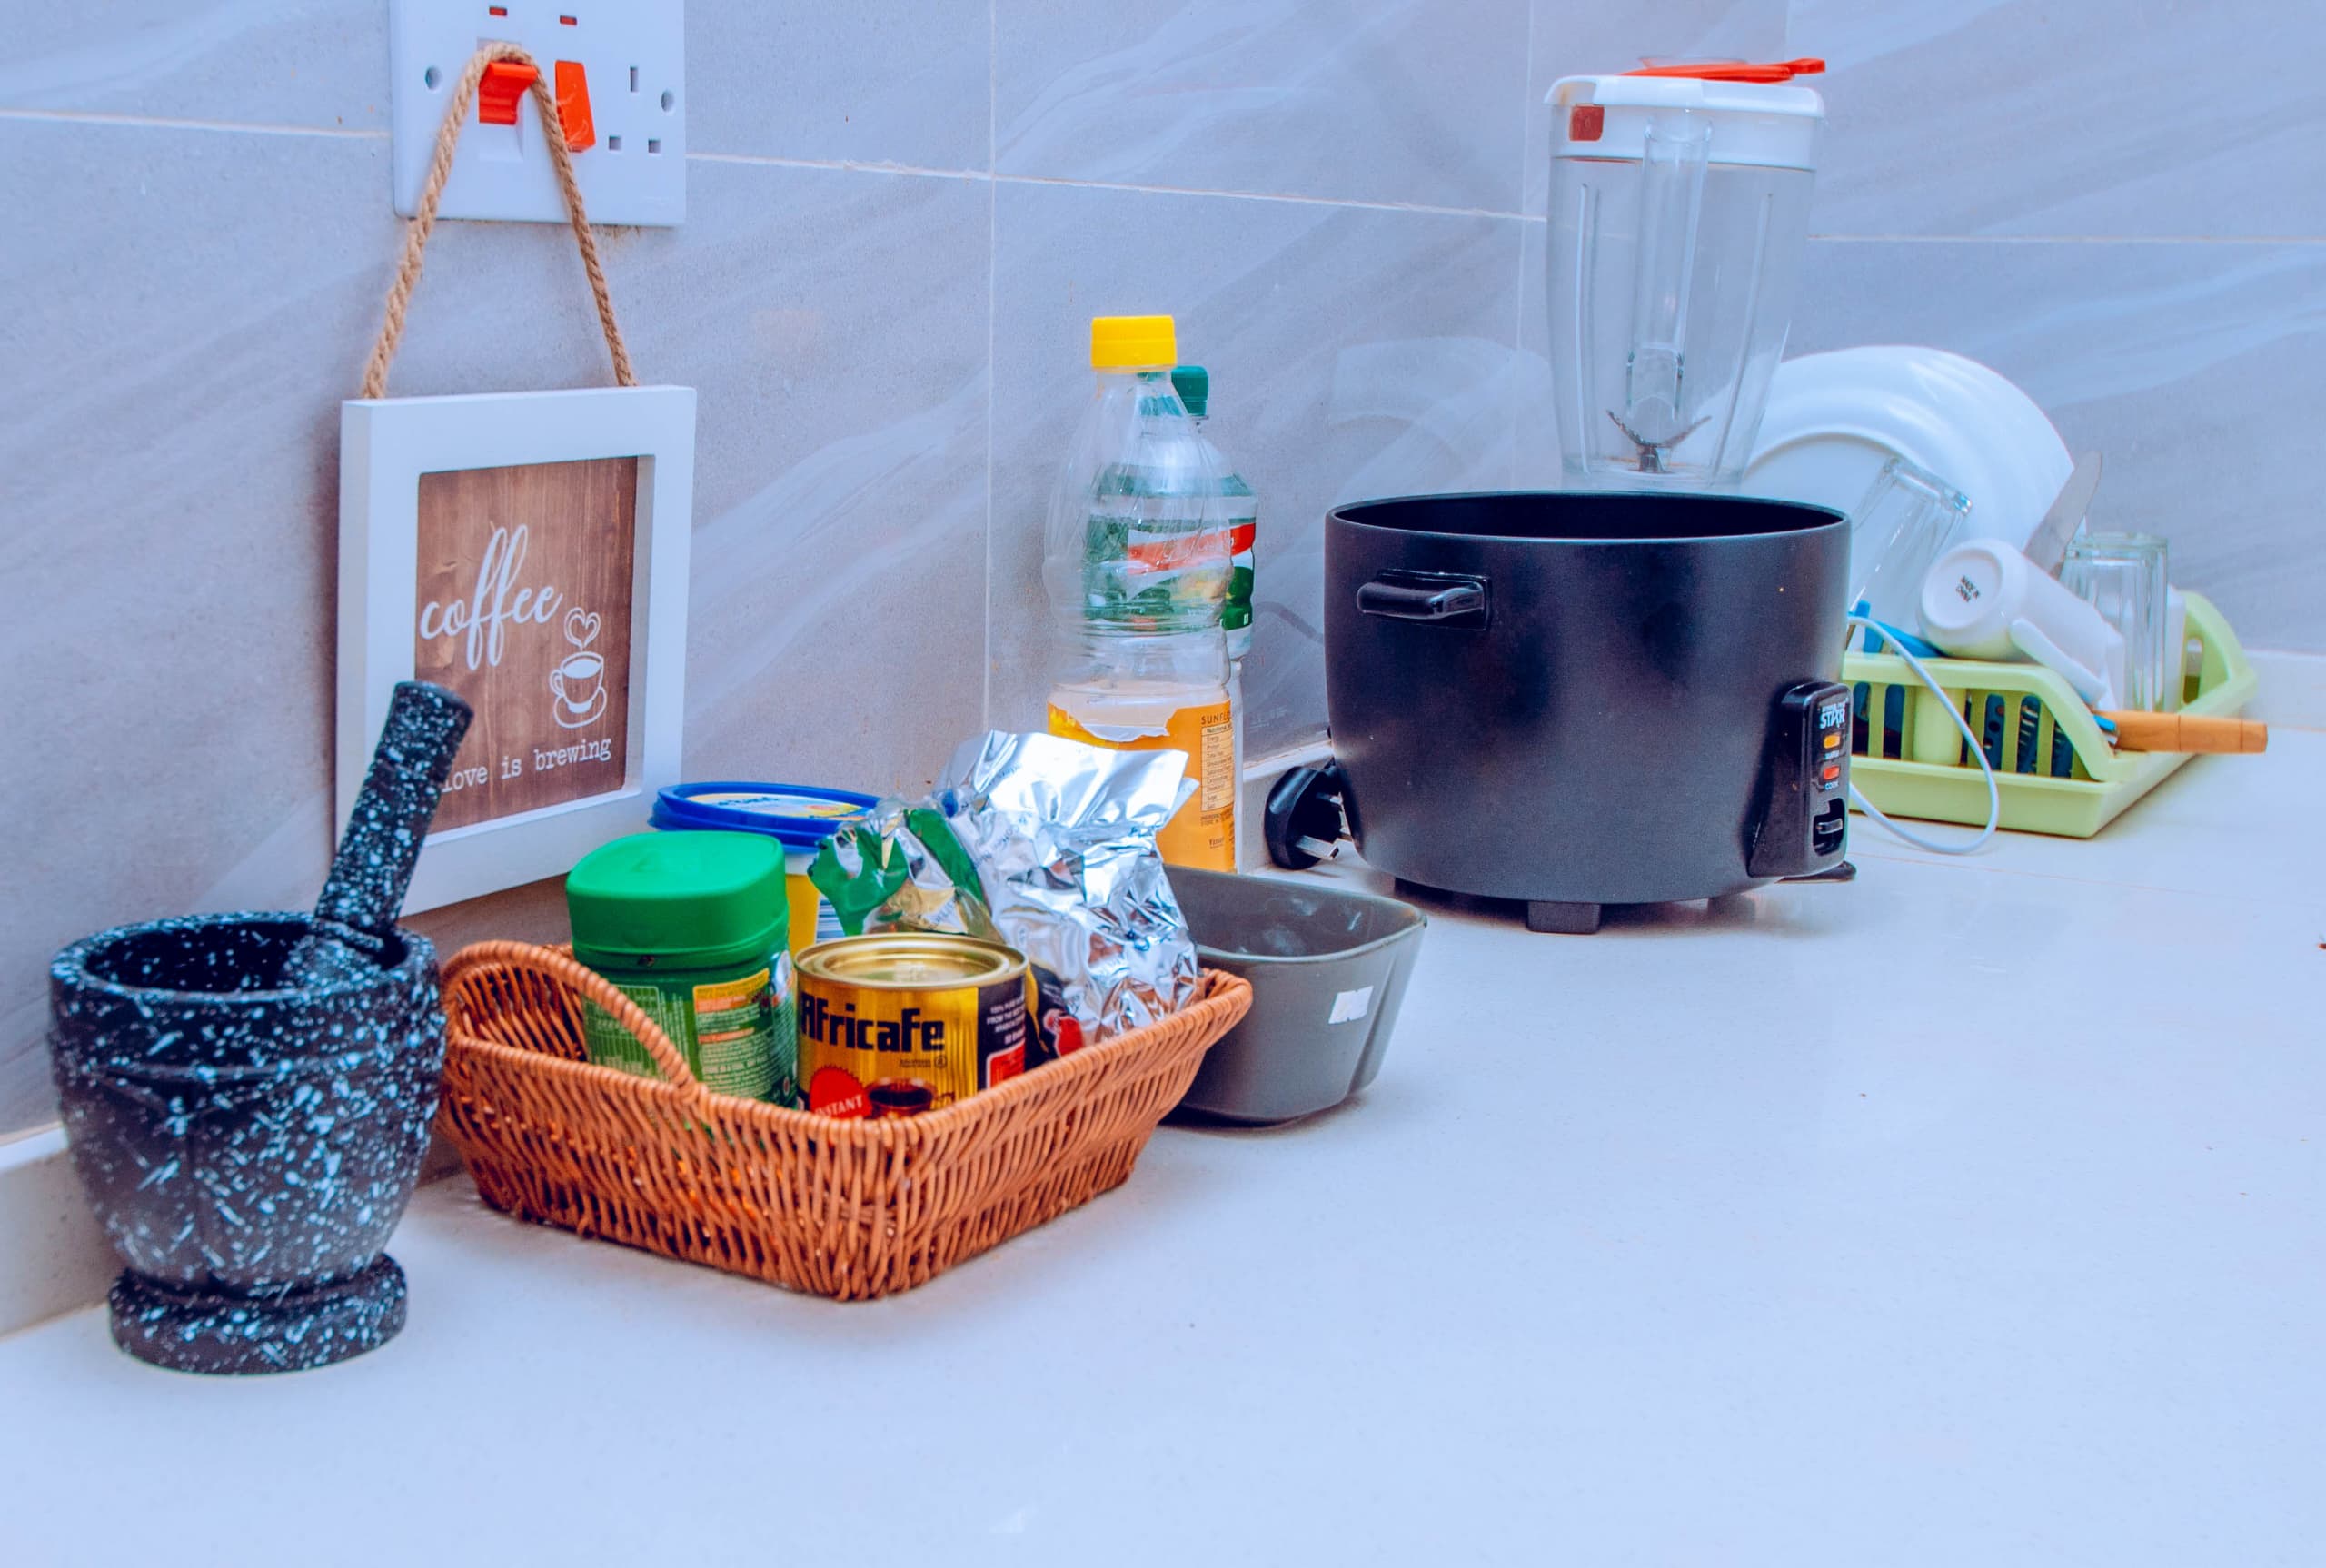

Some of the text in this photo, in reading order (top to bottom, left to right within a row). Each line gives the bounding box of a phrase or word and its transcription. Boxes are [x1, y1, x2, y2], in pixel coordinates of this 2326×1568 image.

[420, 524, 563, 670] coffee
[441, 738, 611, 793] love is brewing
[800, 991, 944, 1052] Africafe
